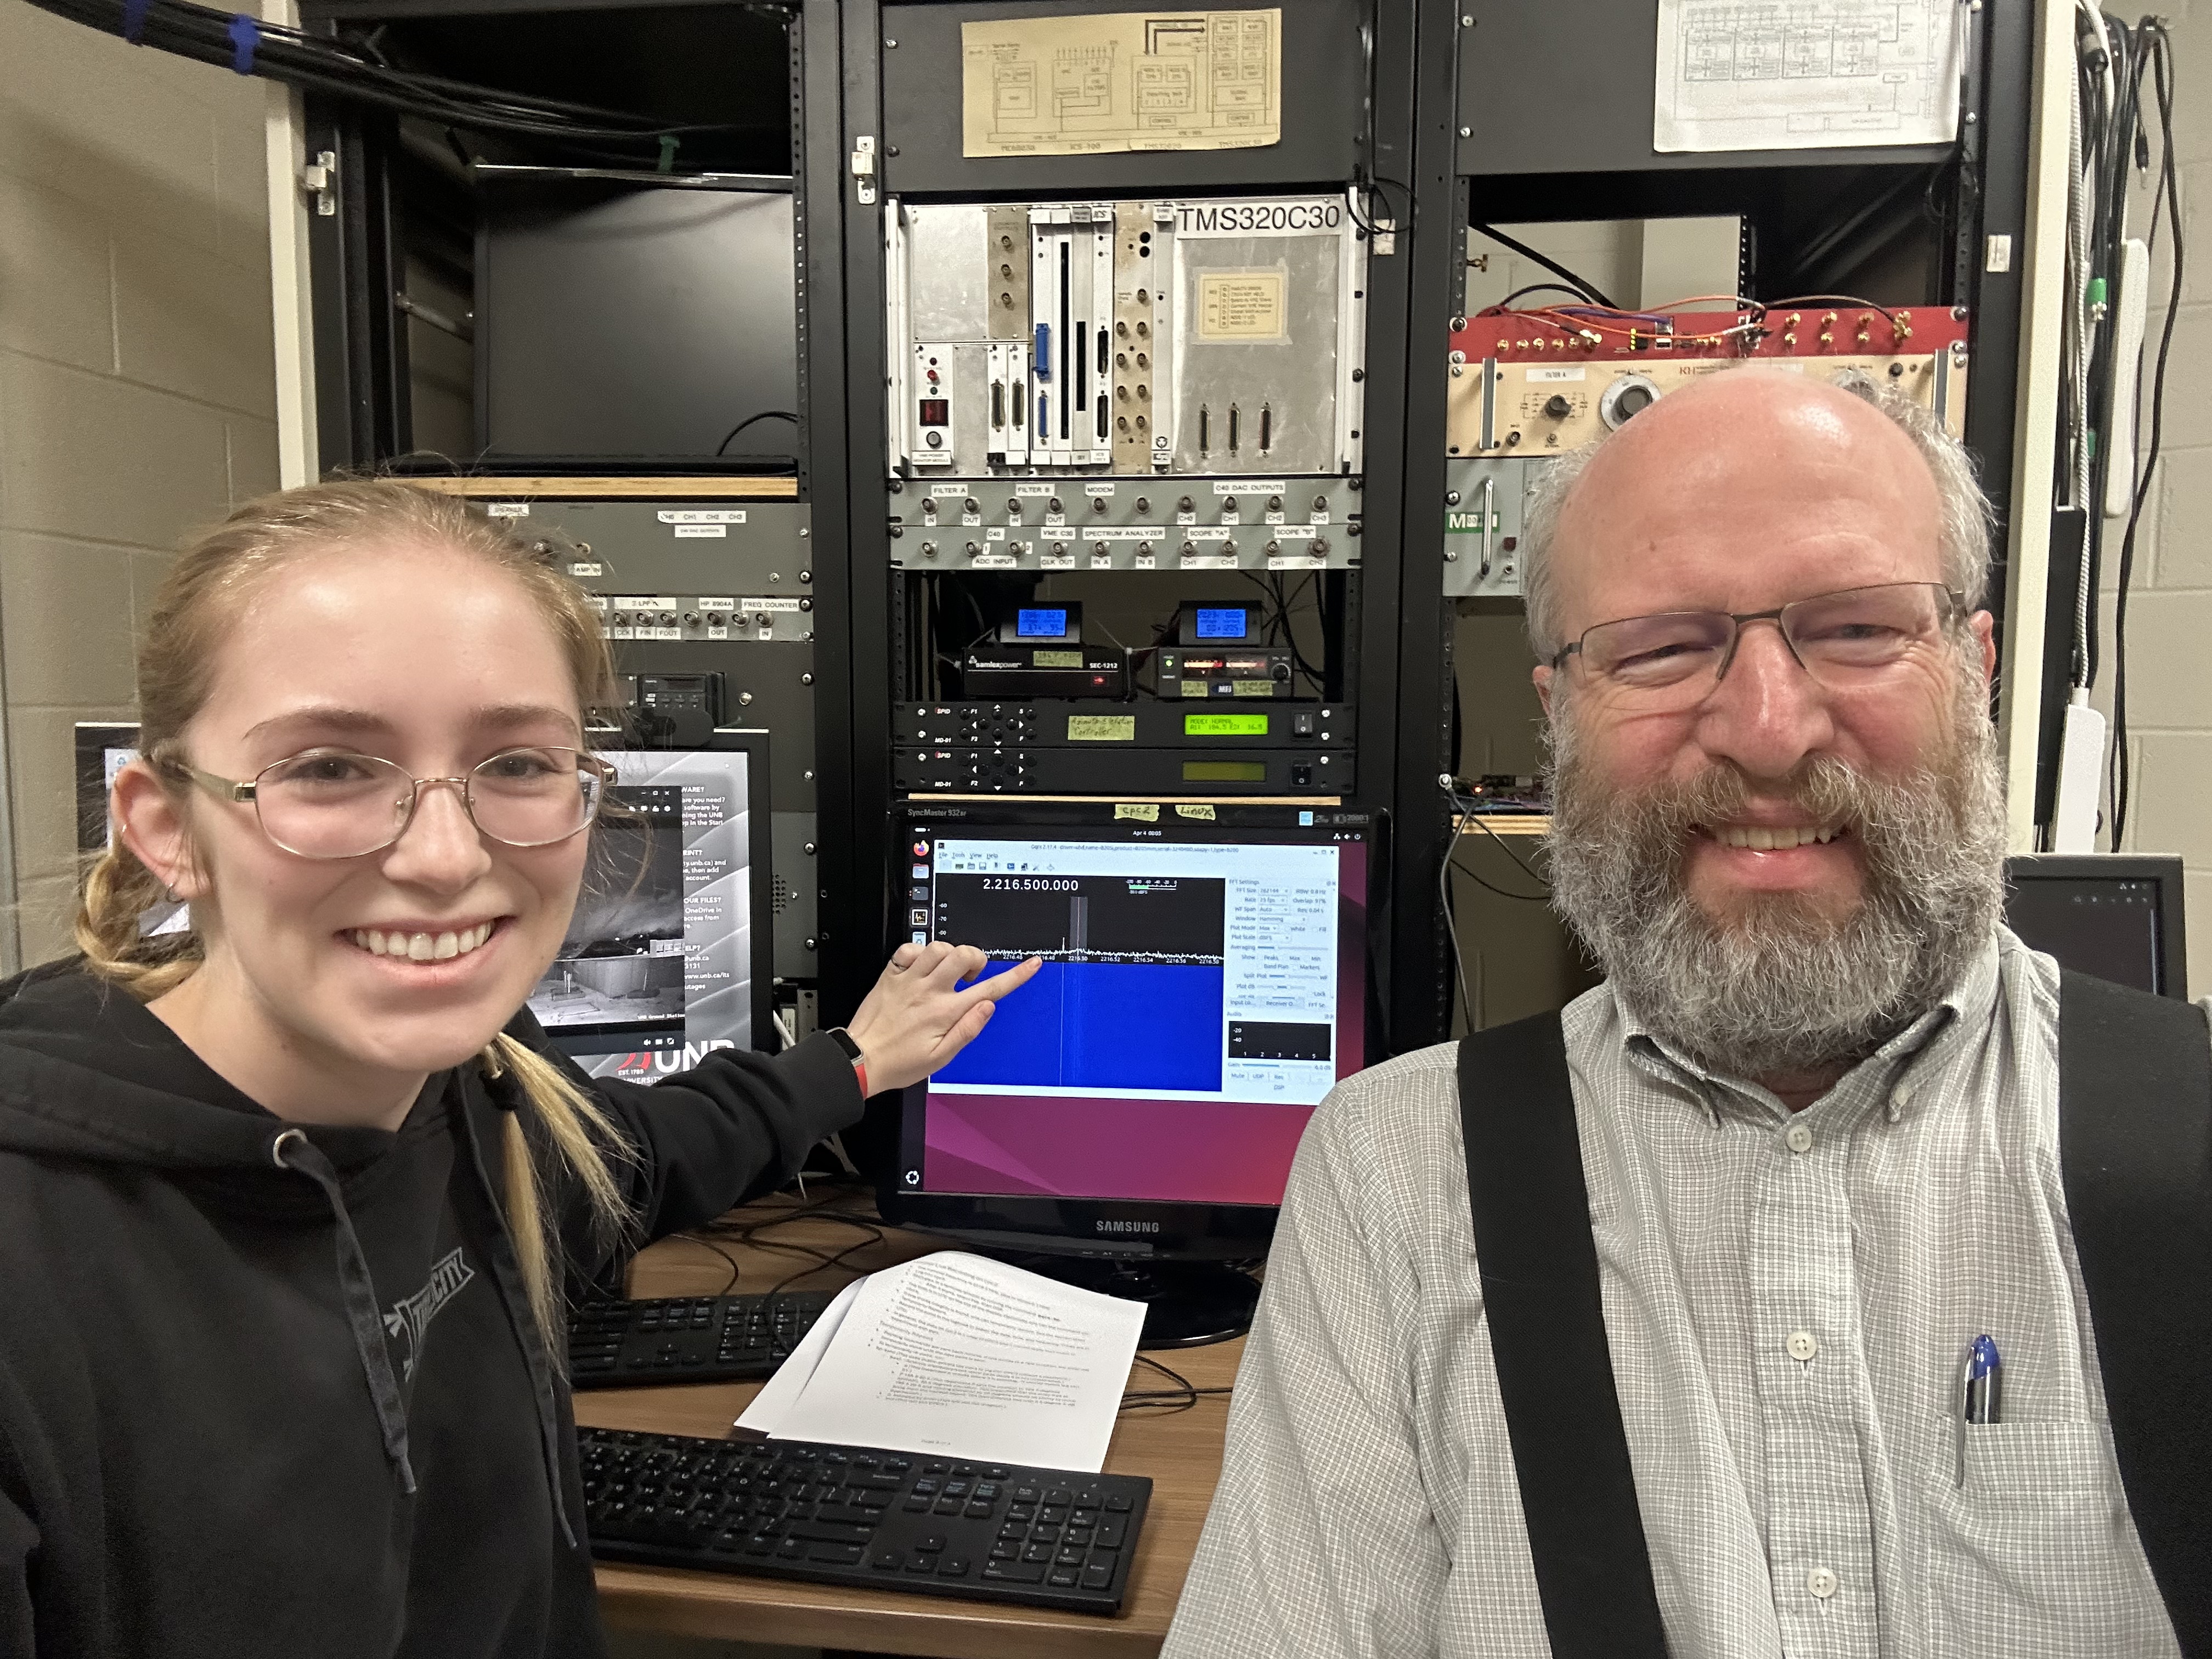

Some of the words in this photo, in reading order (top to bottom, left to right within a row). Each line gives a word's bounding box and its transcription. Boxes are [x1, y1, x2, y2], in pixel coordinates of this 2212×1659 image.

[1177, 206, 1340, 230] TMS320C30
[908, 809, 946, 817] SyncMaster
[983, 878, 1079, 891] 2.216.500.000
[1097, 1221, 1159, 1233] SAMSUNG
